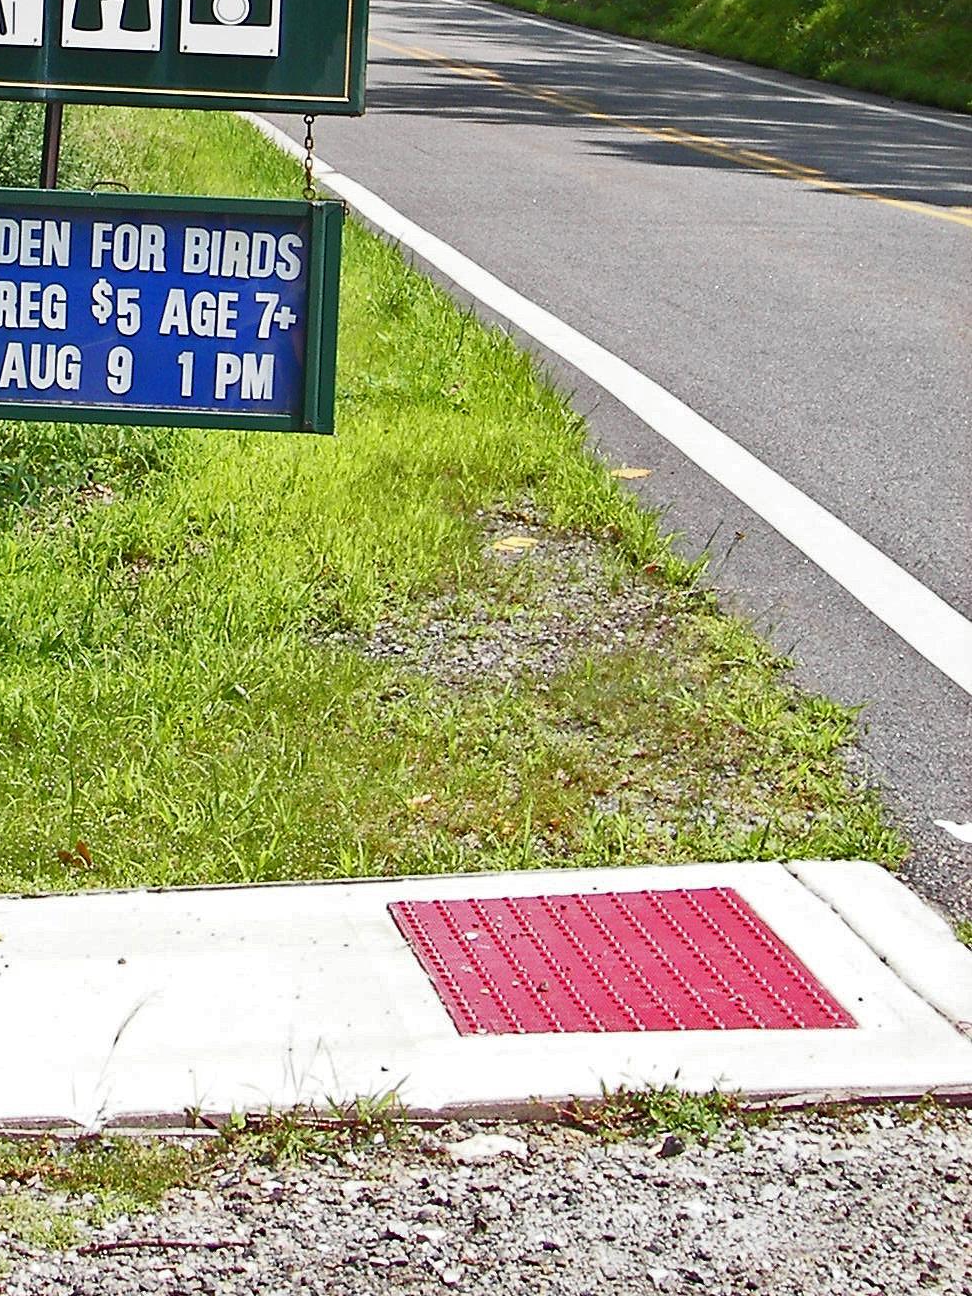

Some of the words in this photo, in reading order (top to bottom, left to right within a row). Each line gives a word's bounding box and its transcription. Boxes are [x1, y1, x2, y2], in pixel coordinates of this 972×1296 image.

[91, 222, 167, 272] FOR
[183, 227, 303, 281] BIRDS
[91, 278, 141, 336] $5
[159, 288, 239, 339] AGE
[255, 292, 297, 339] 7+
[107, 346, 133, 394] 9
[177, 351, 194, 397] 1
[214, 352, 275, 400] PM
